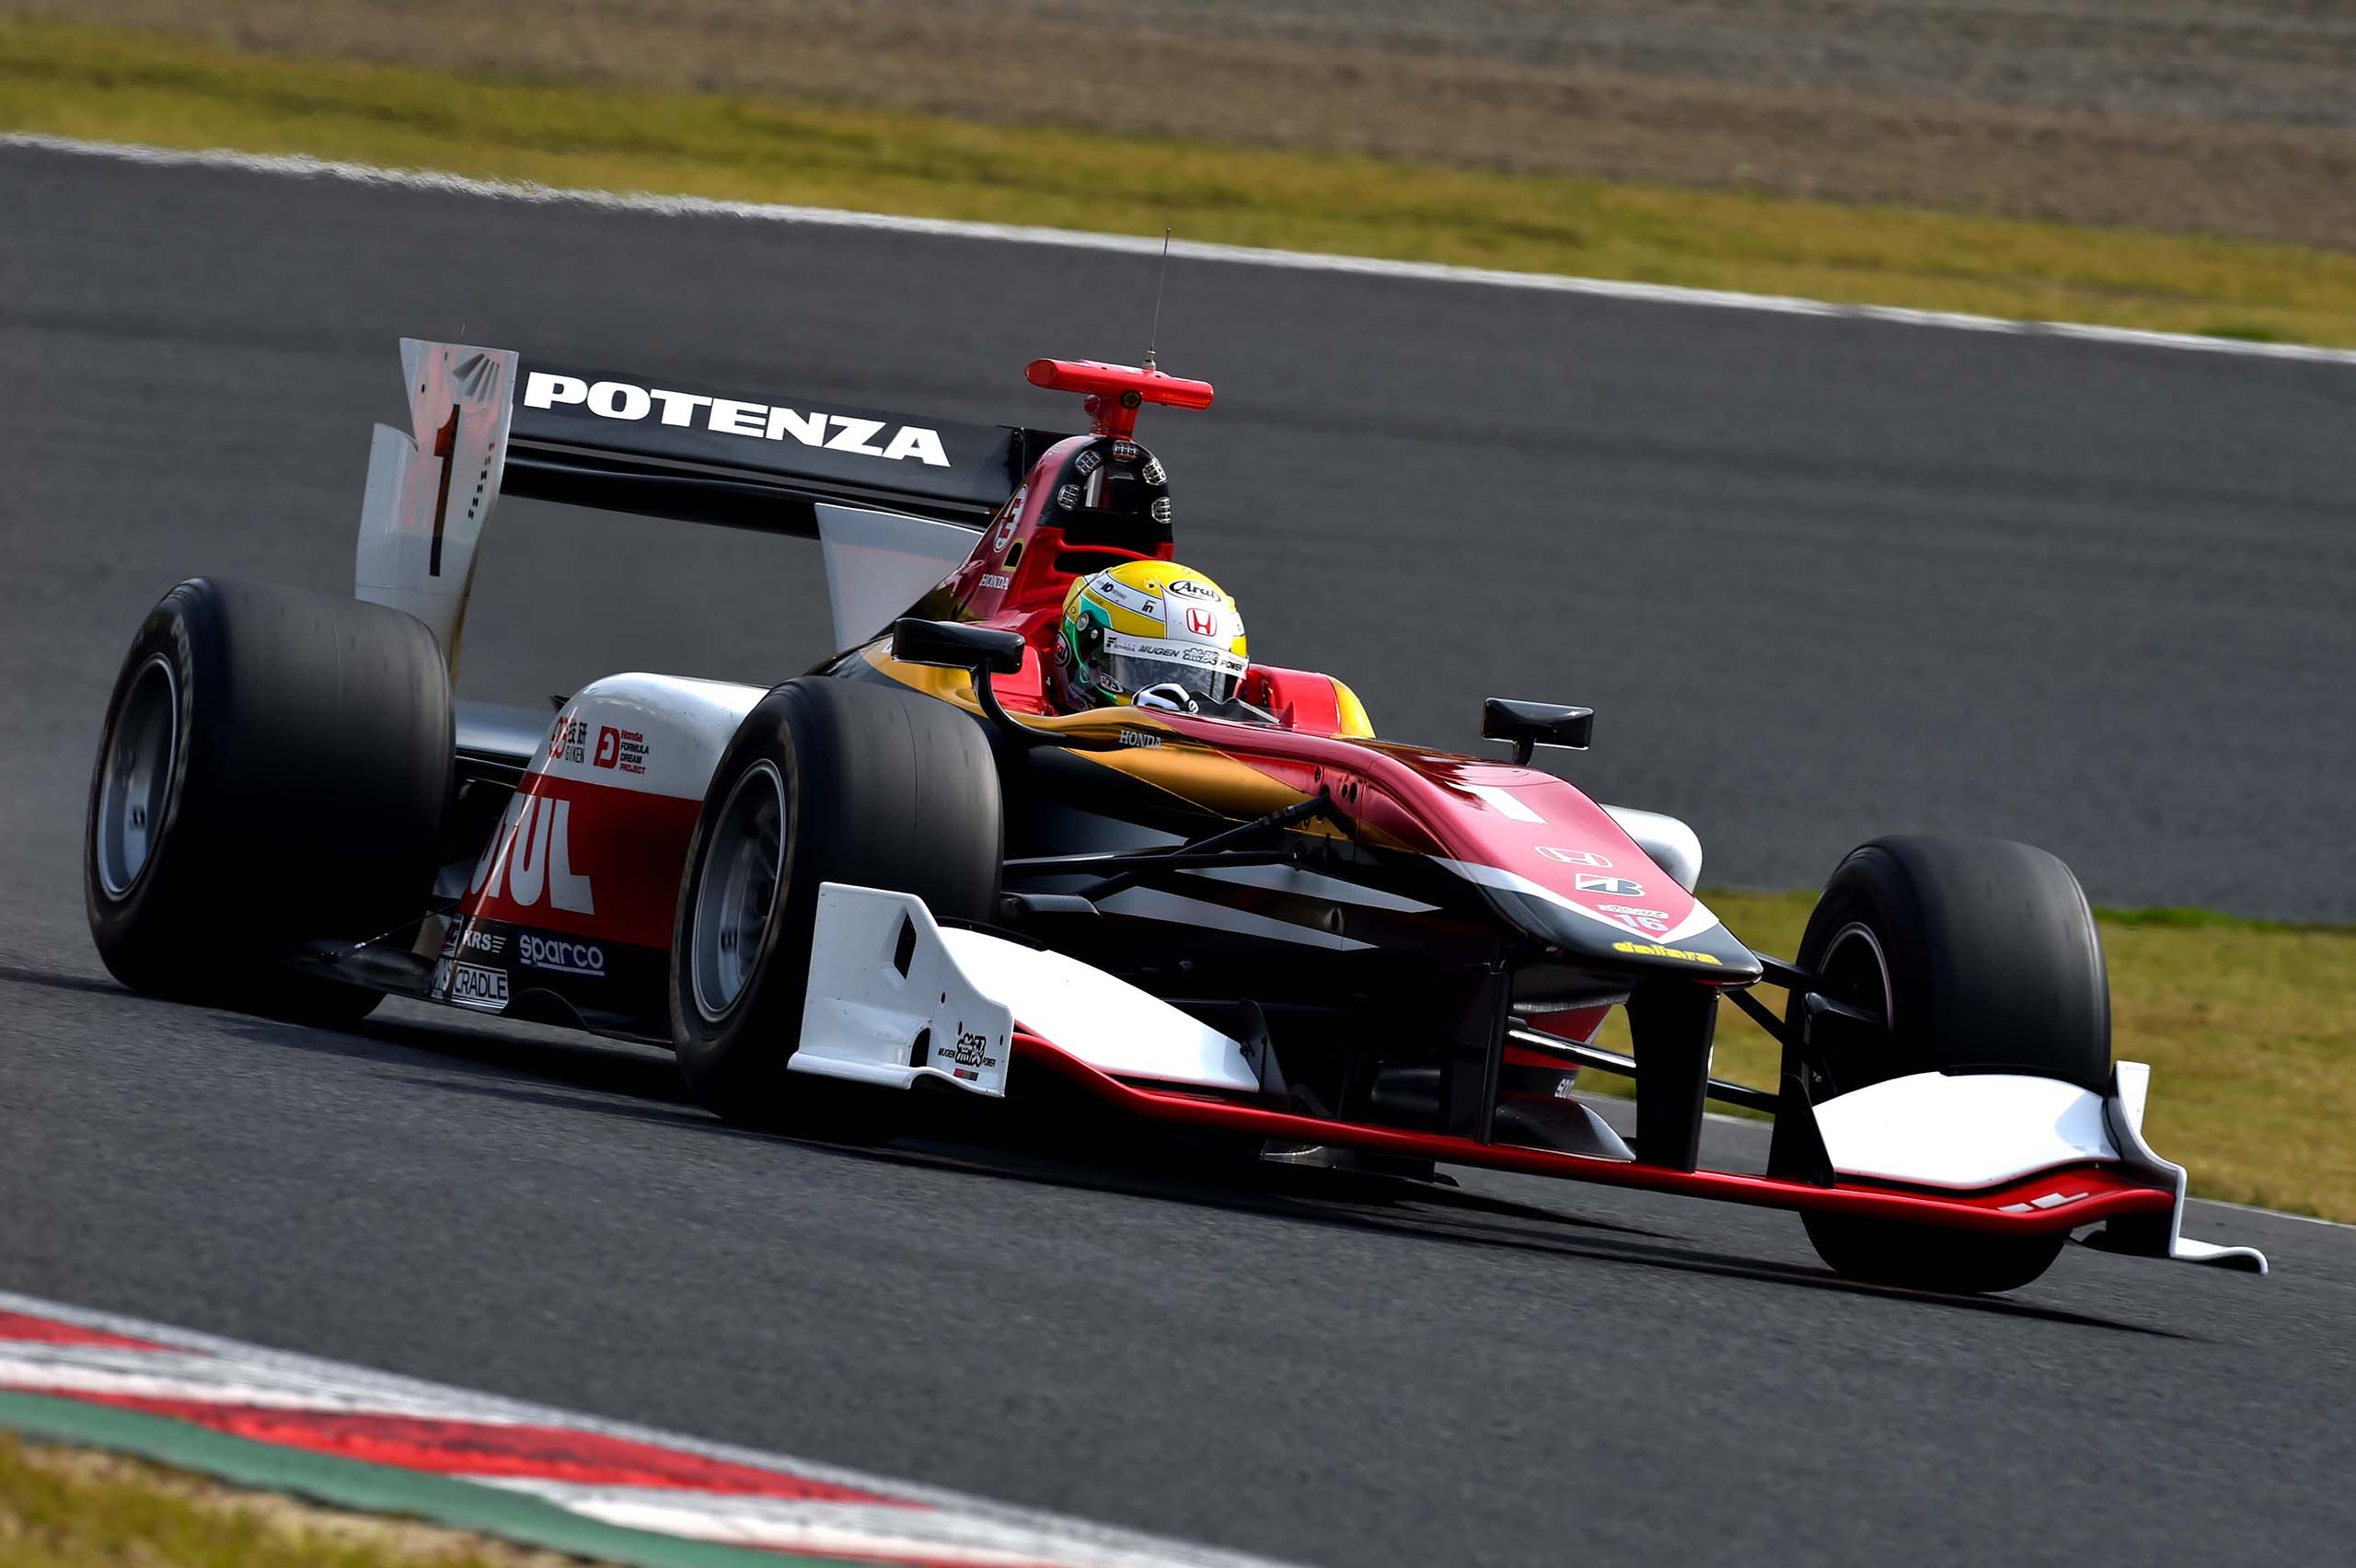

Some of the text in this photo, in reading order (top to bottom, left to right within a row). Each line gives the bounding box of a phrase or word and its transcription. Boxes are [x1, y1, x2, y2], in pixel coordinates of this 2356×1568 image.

[523, 371, 952, 467] POTENZA
[430, 404, 460, 577] 1
[979, 573, 1009, 590] HONDA
[1138, 645, 1180, 657] MUGEN
[1219, 660, 1243, 672] POWER
[621, 729, 643, 742] Honda
[1119, 730, 1161, 751] HONDA
[620, 742, 650, 755] FORMULA
[620, 753, 642, 764] DREAM
[619, 763, 647, 775] PROJECT
[1615, 914, 1669, 931] 16
[519, 934, 605, 970] sparco
[1612, 940, 1723, 966] dallara
[455, 969, 508, 1000] CRADLE
[937, 1047, 956, 1059] MUGEN
[982, 1056, 997, 1067] POWER
